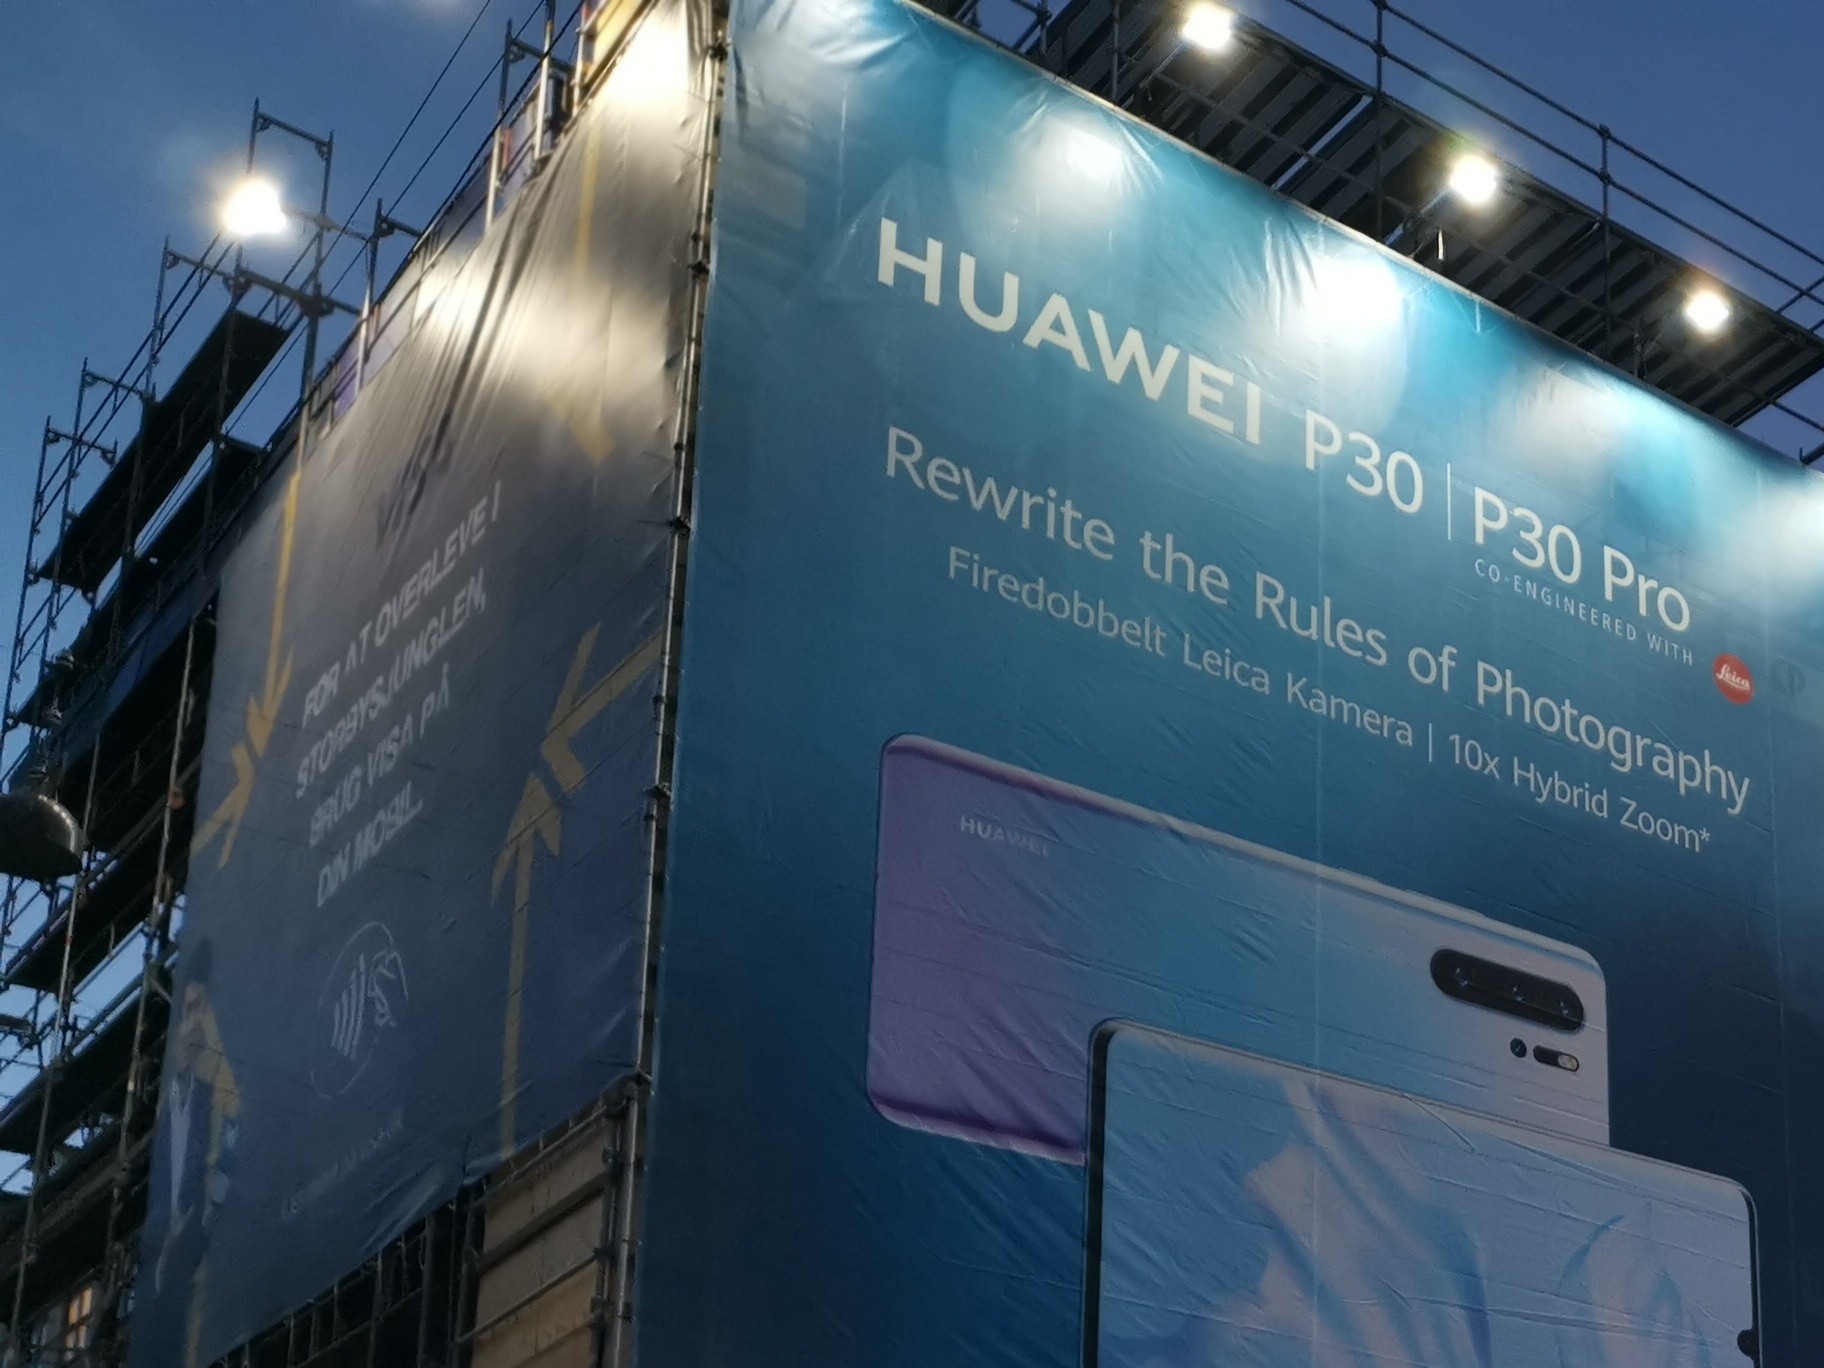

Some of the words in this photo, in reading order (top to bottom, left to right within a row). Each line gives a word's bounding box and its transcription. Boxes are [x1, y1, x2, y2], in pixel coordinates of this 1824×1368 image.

[877, 217, 1262, 444] HUAWEI
[1304, 408, 1424, 515] P30
[1472, 484, 1582, 585] P30
[1602, 544, 1691, 632] Pro
[373, 495, 490, 648] OVERLEVE
[885, 425, 1117, 562] Rewrite
[1139, 529, 1230, 606] the
[1253, 571, 1389, 667] Rules
[1407, 637, 1458, 695] of
[1475, 660, 1751, 815] Photography
[1474, 558, 1637, 642] CO-ENGINEERED
[1646, 631, 1694, 667] WITH
[365, 711, 415, 787] VISA
[947, 546, 1167, 659] Firedobbelt
[1182, 633, 1272, 696] Leica
[1285, 672, 1415, 748] Kamera
[1449, 732, 1502, 782] 10x
[1512, 754, 1609, 822] Hybrid
[1715, 663, 1752, 690] Leica
